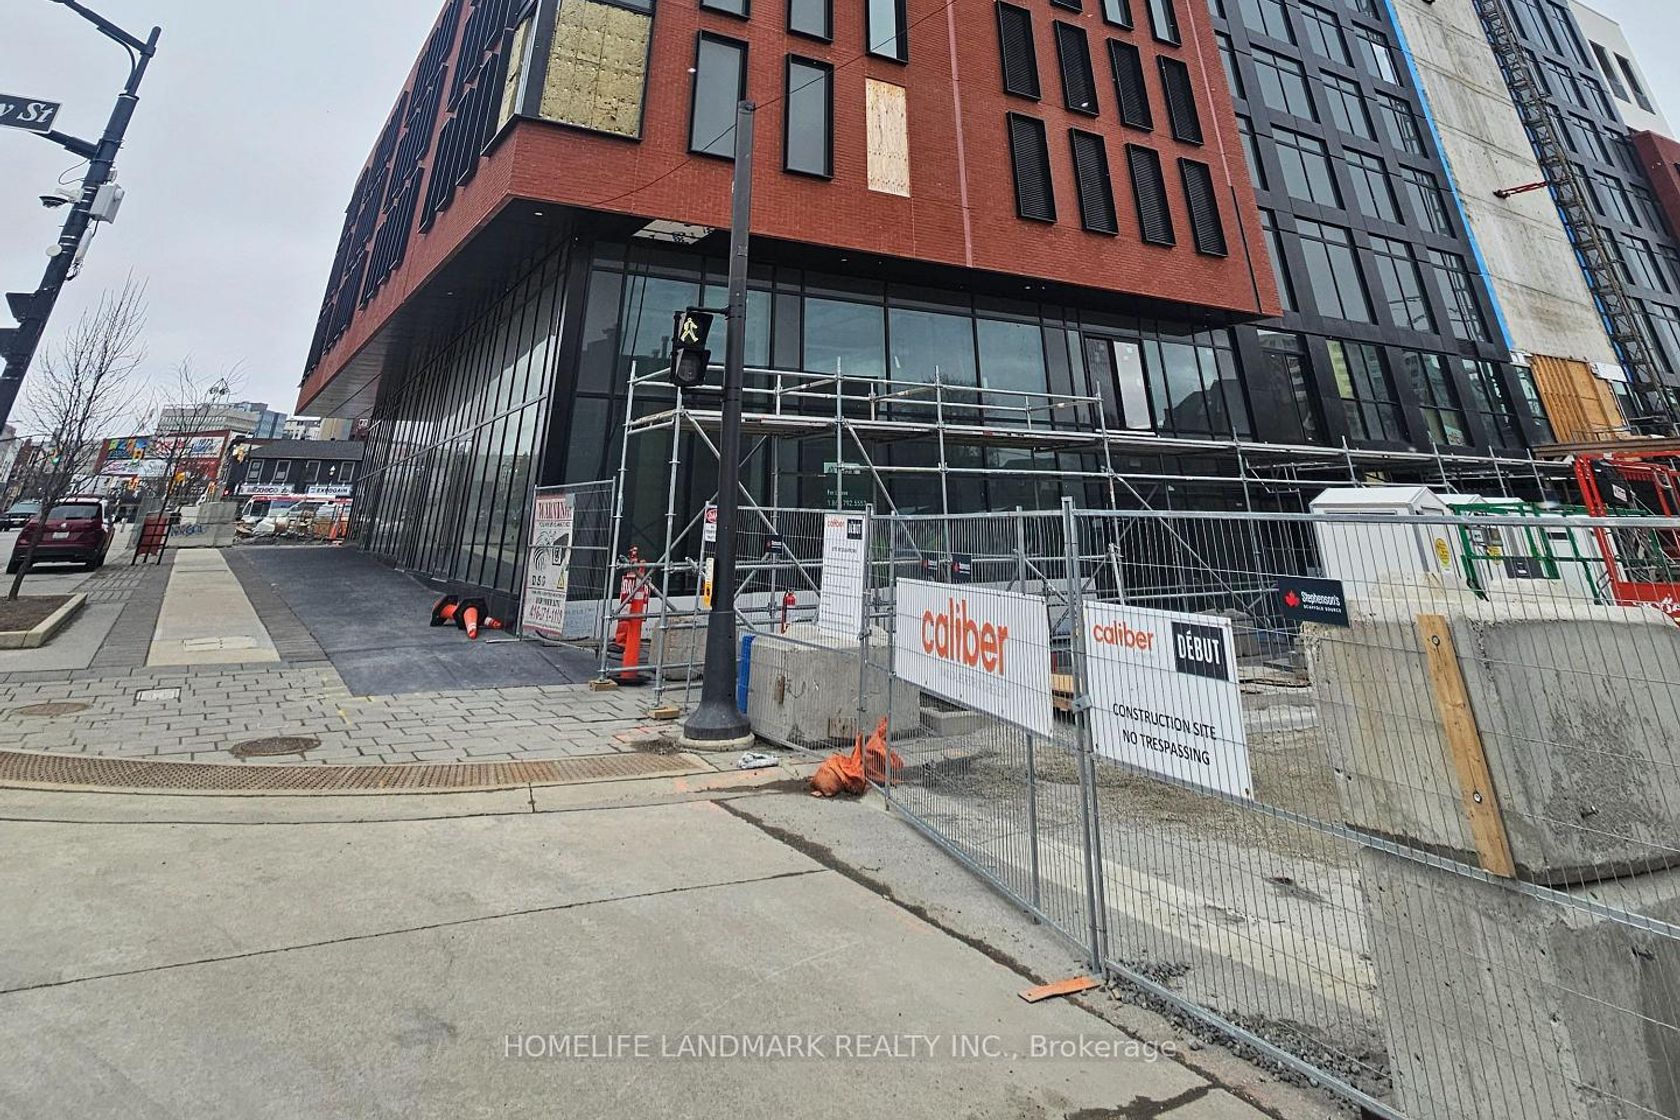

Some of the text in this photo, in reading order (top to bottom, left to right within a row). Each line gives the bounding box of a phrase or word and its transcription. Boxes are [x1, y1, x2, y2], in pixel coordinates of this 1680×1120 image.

[16, 102, 54, 123] St
[1301, 591, 1341, 607] Stephenson's
[921, 597, 1009, 677] caliber
[1092, 620, 1154, 651] caliber
[1176, 631, 1220, 665] DÉBUT
[1112, 703, 1217, 740] CONSTRUCTION SITE
[1122, 729, 1211, 766] NO TRESPASSING
